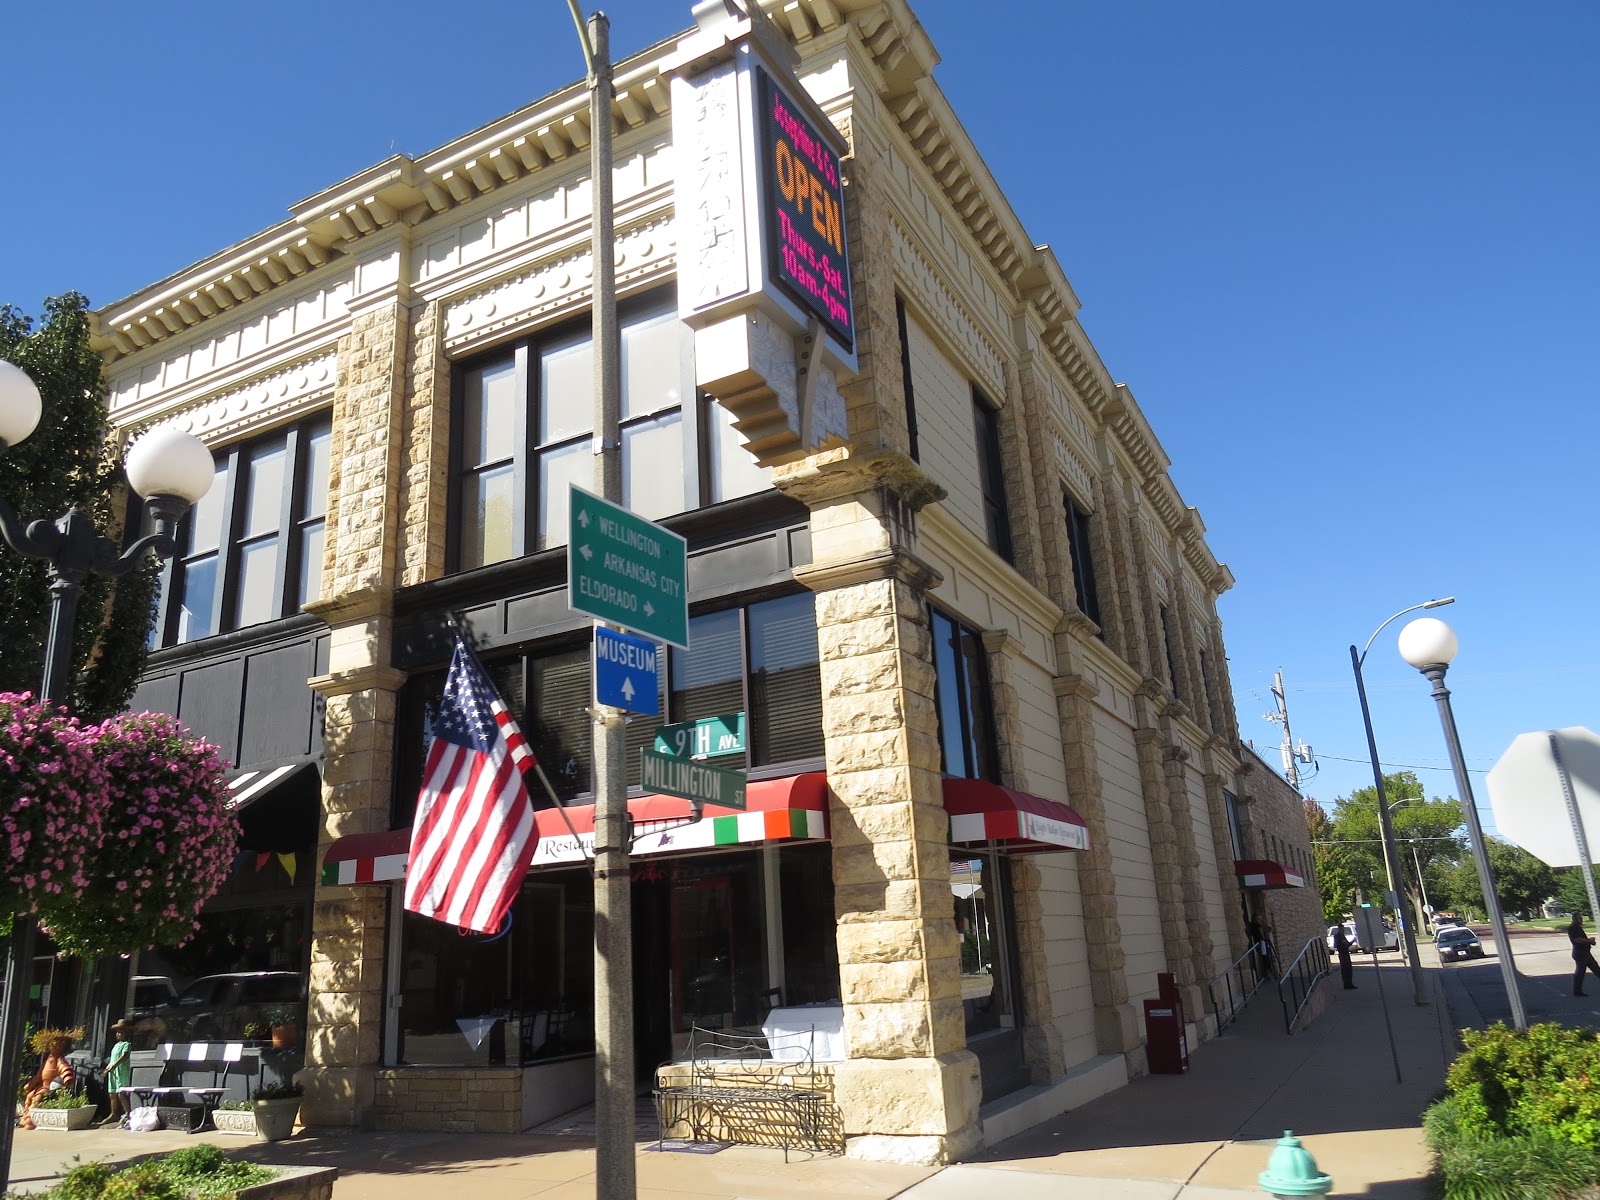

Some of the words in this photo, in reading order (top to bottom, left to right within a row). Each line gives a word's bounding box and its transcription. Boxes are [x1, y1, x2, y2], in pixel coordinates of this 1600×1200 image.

[775, 138, 843, 256] OPEN
[599, 515, 661, 558] WELLINGTON
[580, 575, 637, 612] ELDORADO
[603, 551, 657, 588] ARKANSAS
[660, 575, 680, 598] CITY
[597, 635, 656, 674] MUSEUM
[675, 725, 710, 757] 9TH
[718, 732, 741, 751] AVE
[645, 755, 721, 800] MILLINGTON
[735, 790, 744, 805] ST
[540, 839, 597, 859] Restaur
